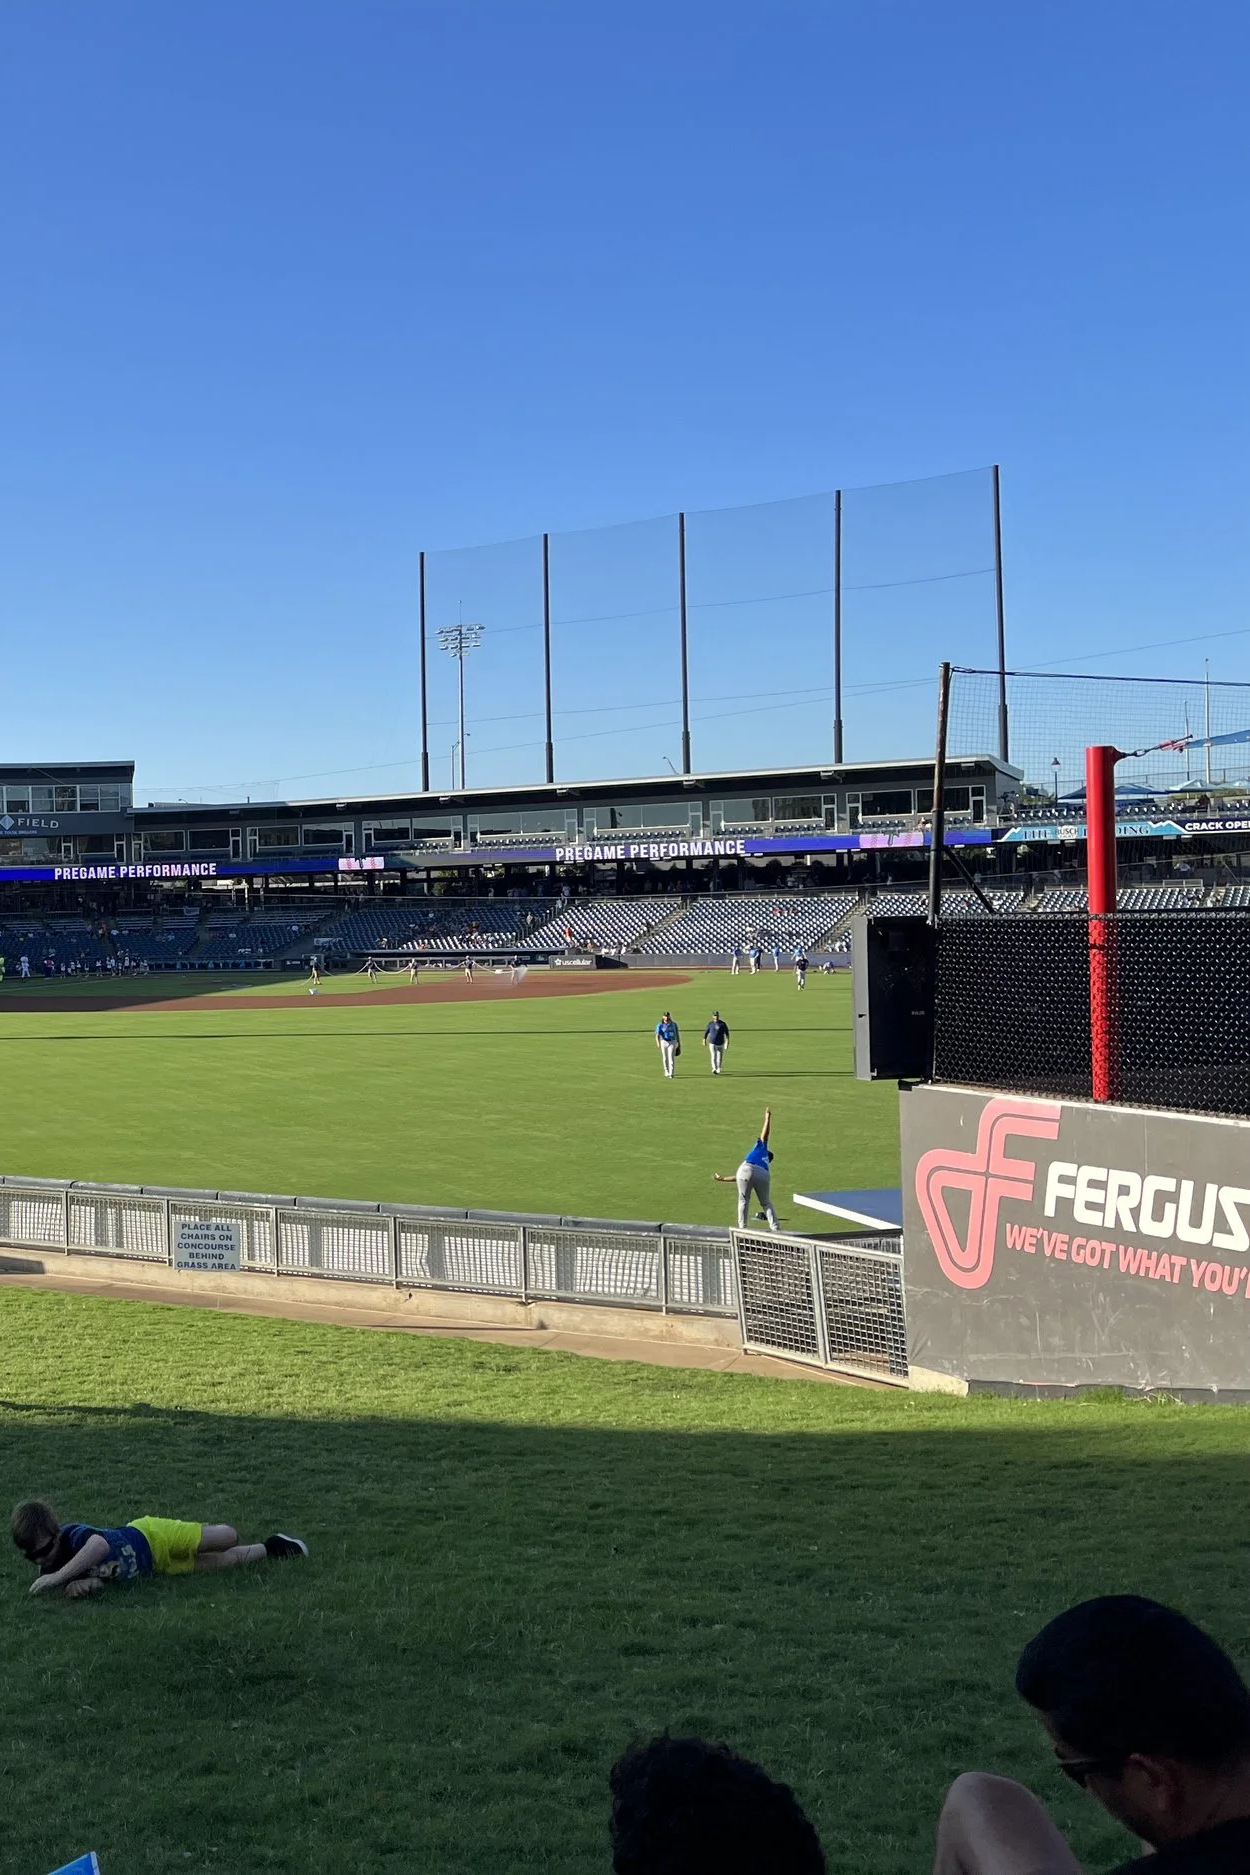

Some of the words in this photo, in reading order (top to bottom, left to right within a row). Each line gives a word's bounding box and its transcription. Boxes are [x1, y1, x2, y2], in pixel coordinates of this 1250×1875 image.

[17, 817, 59, 830] FIELD
[1185, 821, 1224, 831] CRACK
[555, 844, 626, 862] PREGAME
[630, 839, 746, 859] PERFORMANCE
[54, 866, 115, 881] PREGAME
[119, 863, 217, 879] PERFORMANCE
[1044, 1161, 1250, 1251] FERGUS
[181, 1223, 211, 1231] PLACE
[180, 1233, 216, 1241] CHAIRS
[177, 1242, 236, 1251] CONCOURSE
[188, 1252, 225, 1260] BEHIND
[1005, 1222, 1068, 1261] WE'VE
[1071, 1236, 1116, 1269] GOT
[1118, 1245, 1189, 1284] WHAT
[1190, 1260, 1250, 1299] YOU'
[177, 1261, 208, 1269] GRASS
